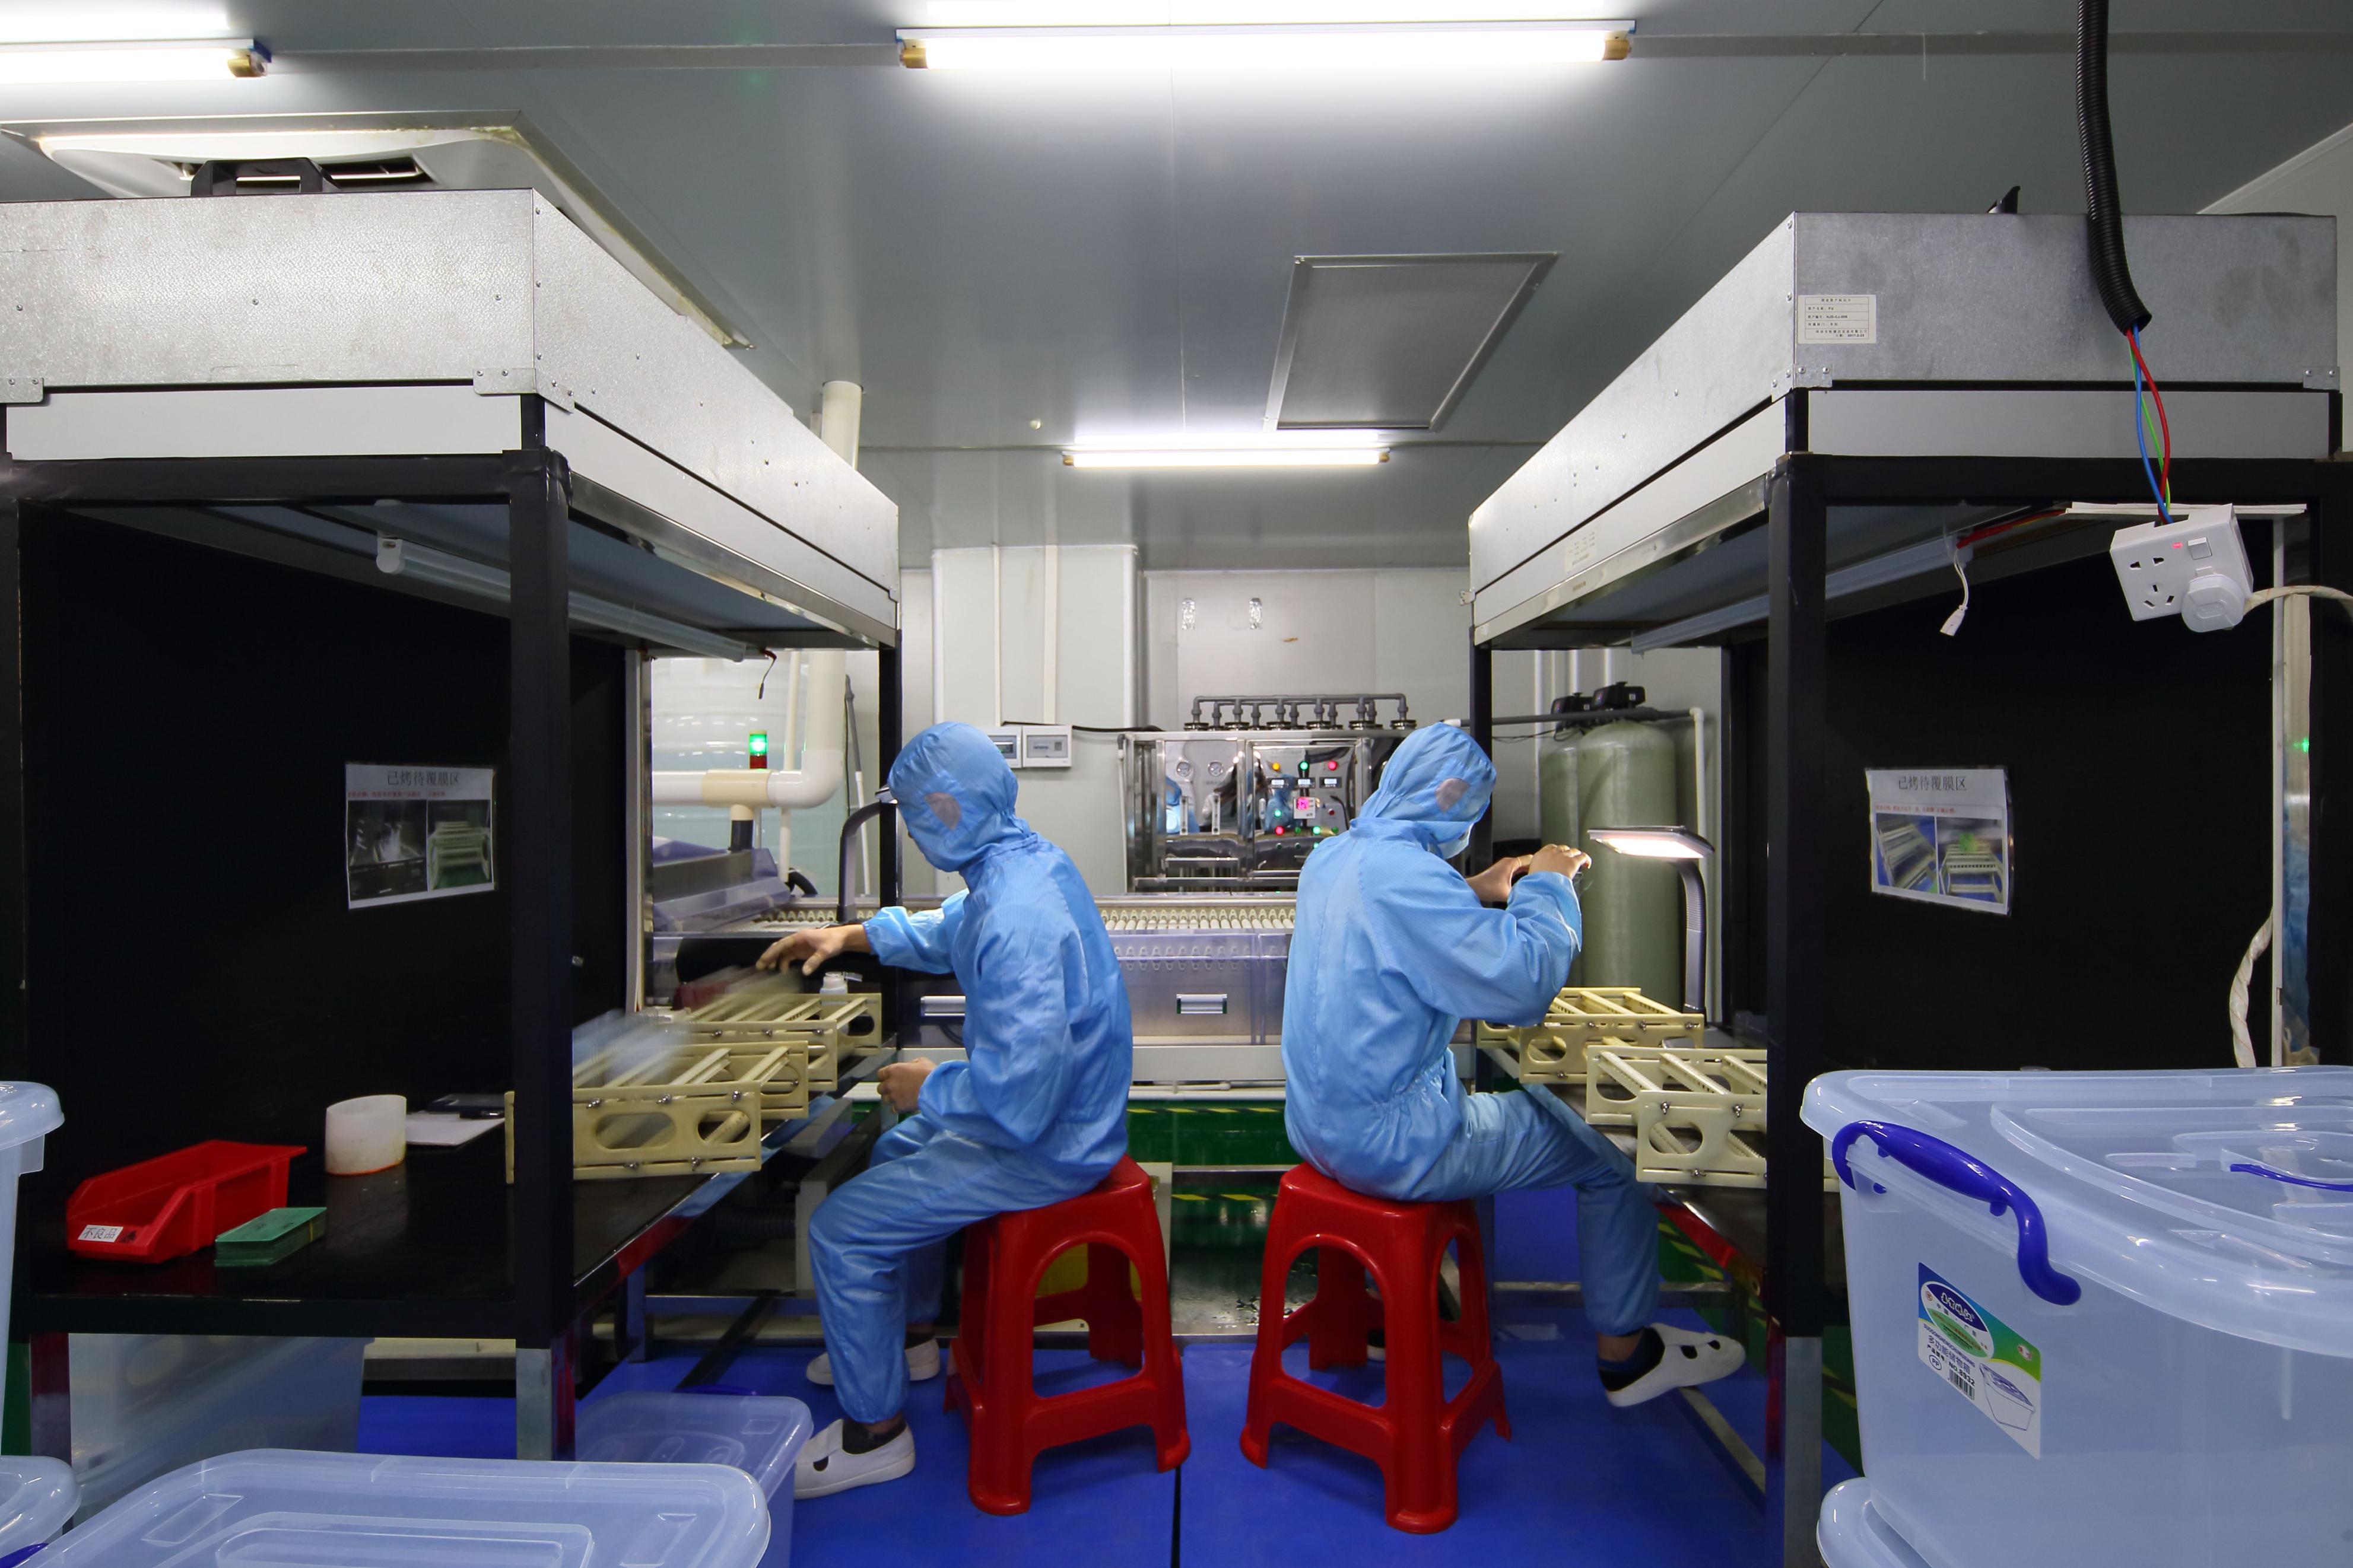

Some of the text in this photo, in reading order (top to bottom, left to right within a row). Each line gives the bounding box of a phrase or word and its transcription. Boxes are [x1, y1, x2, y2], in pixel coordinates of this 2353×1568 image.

[388, 771, 460, 787] 已烤待覆膜区
[1898, 775, 1967, 791] 已烤待覆膜区
[83, 1227, 118, 1239] 不良品
[1928, 1335, 1970, 1375] 多功能储物箱
[1949, 1362, 1975, 1386] NO.8932
